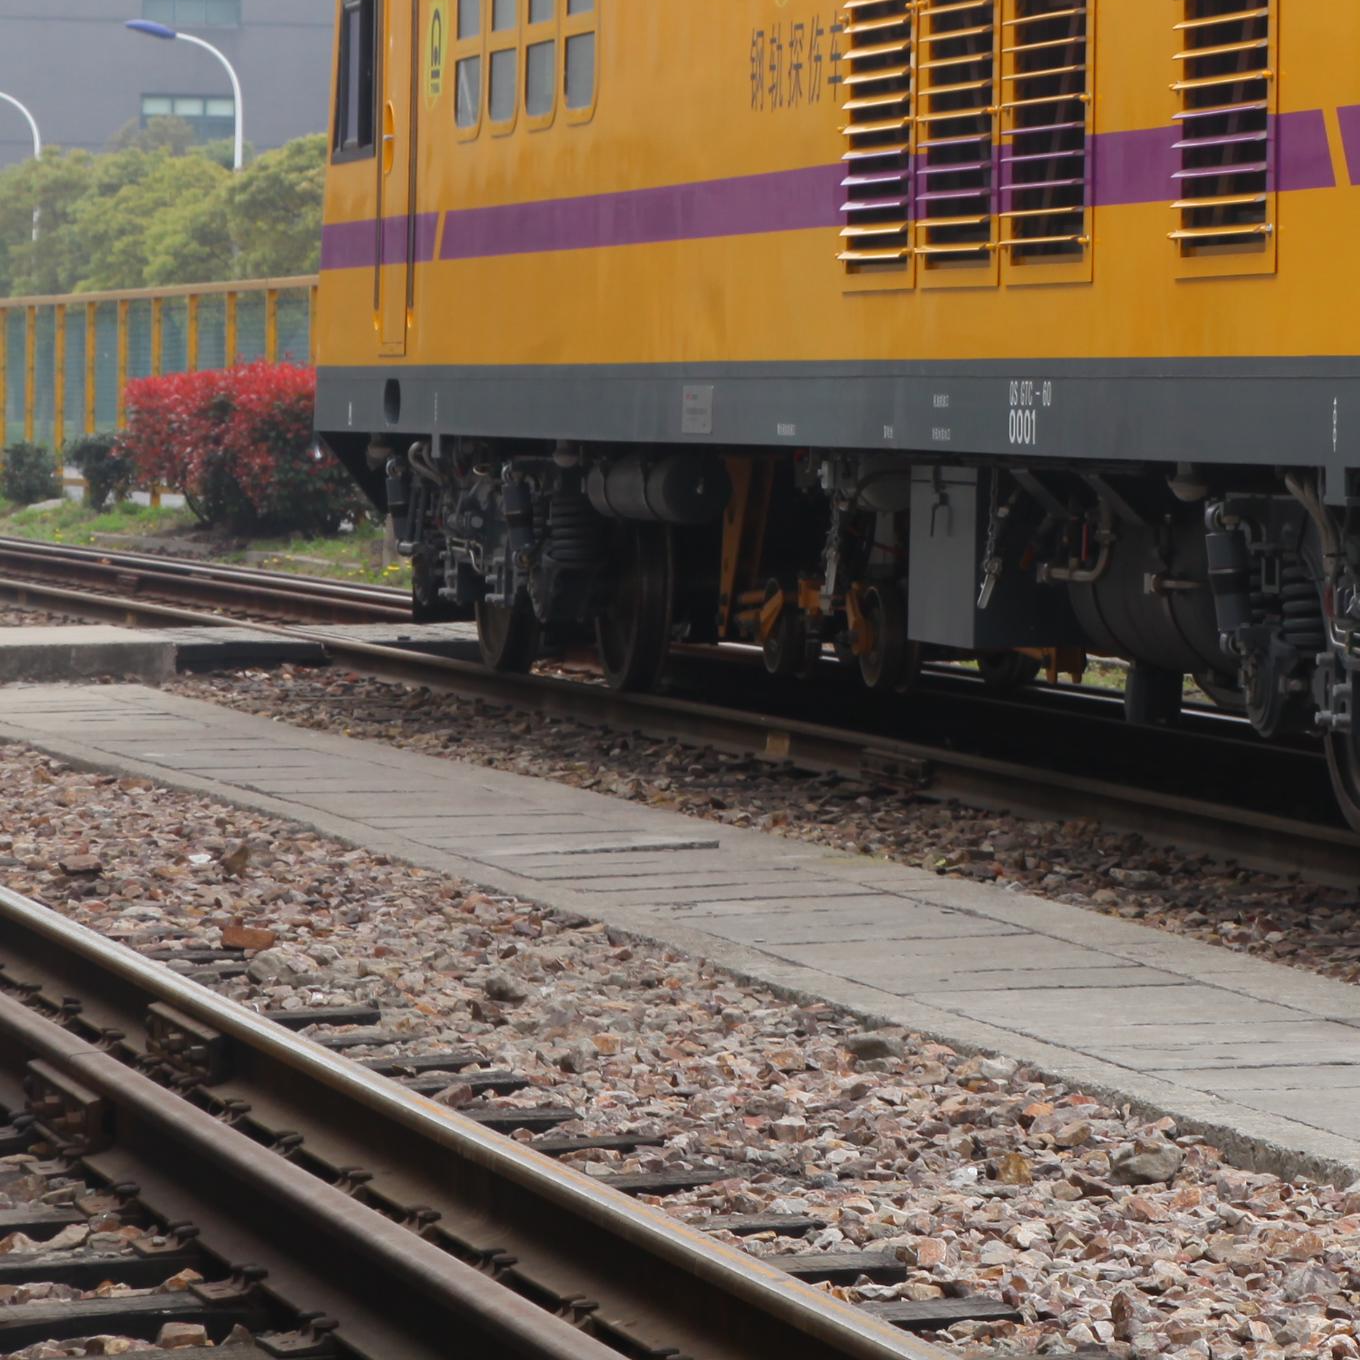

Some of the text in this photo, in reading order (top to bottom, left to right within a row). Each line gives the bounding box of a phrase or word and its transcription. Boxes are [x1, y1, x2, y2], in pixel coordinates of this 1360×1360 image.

[750, 10, 844, 112] 钢轨探伤车
[1009, 409, 1036, 445] 0001
